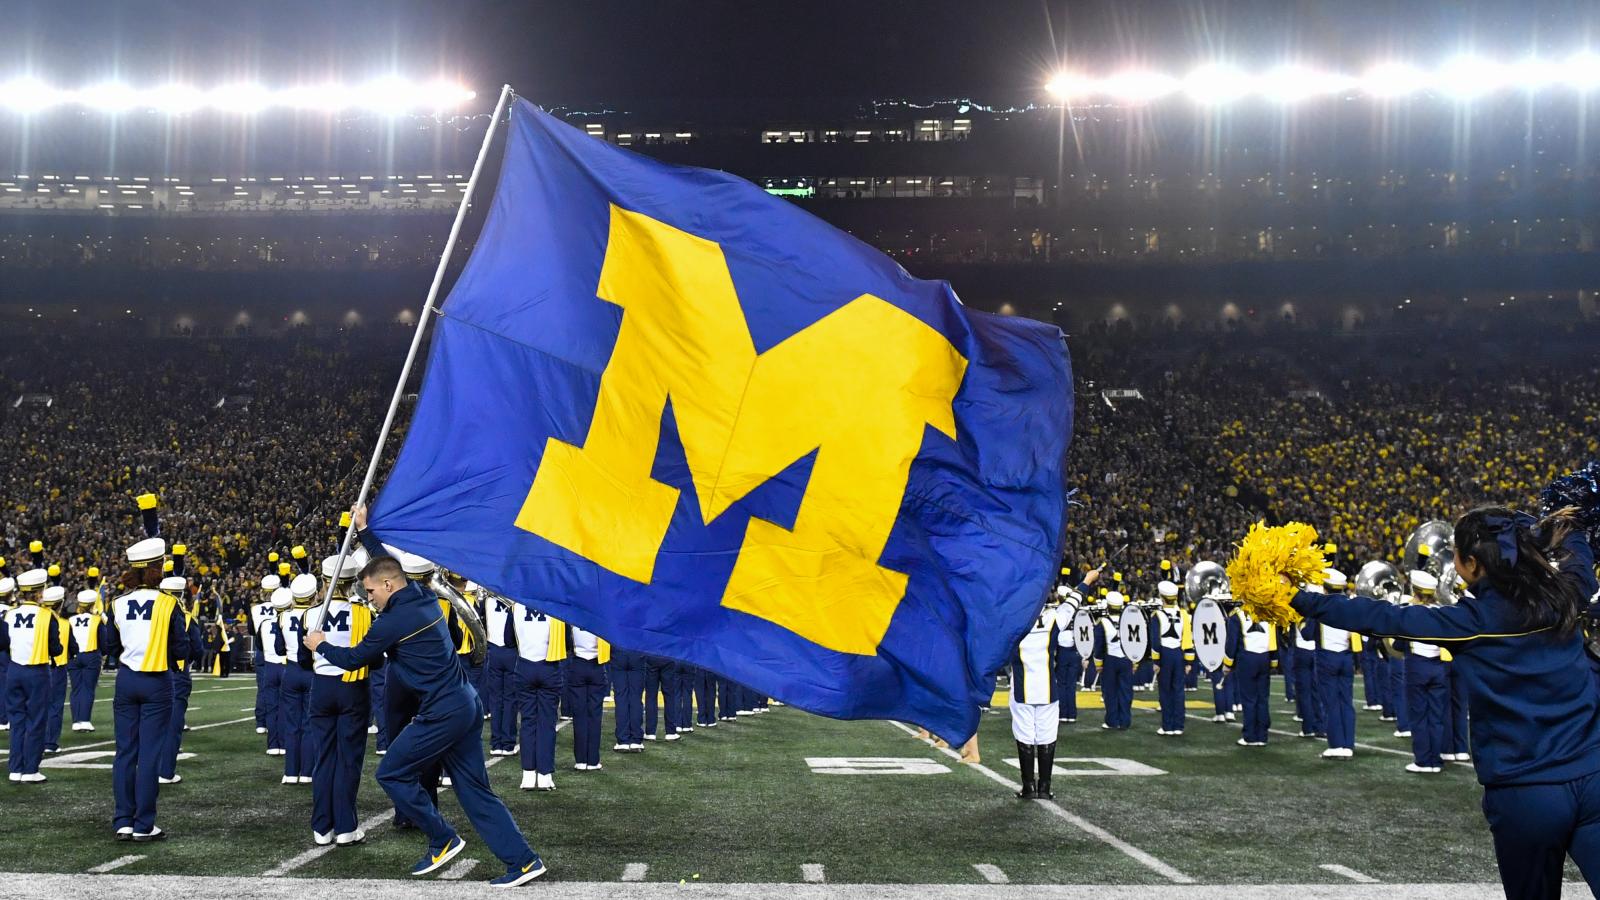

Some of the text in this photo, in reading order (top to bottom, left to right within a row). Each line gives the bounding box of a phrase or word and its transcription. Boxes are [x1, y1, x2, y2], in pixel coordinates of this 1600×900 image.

[514, 202, 969, 657] M
[126, 600, 155, 620] M
[260, 606, 274, 616] M
[14, 613, 36, 628] M
[75, 617, 90, 627] M
[323, 610, 350, 631] M
[1079, 626, 1089, 641] M
[1127, 624, 1140, 642] M
[1202, 622, 1218, 644] M
